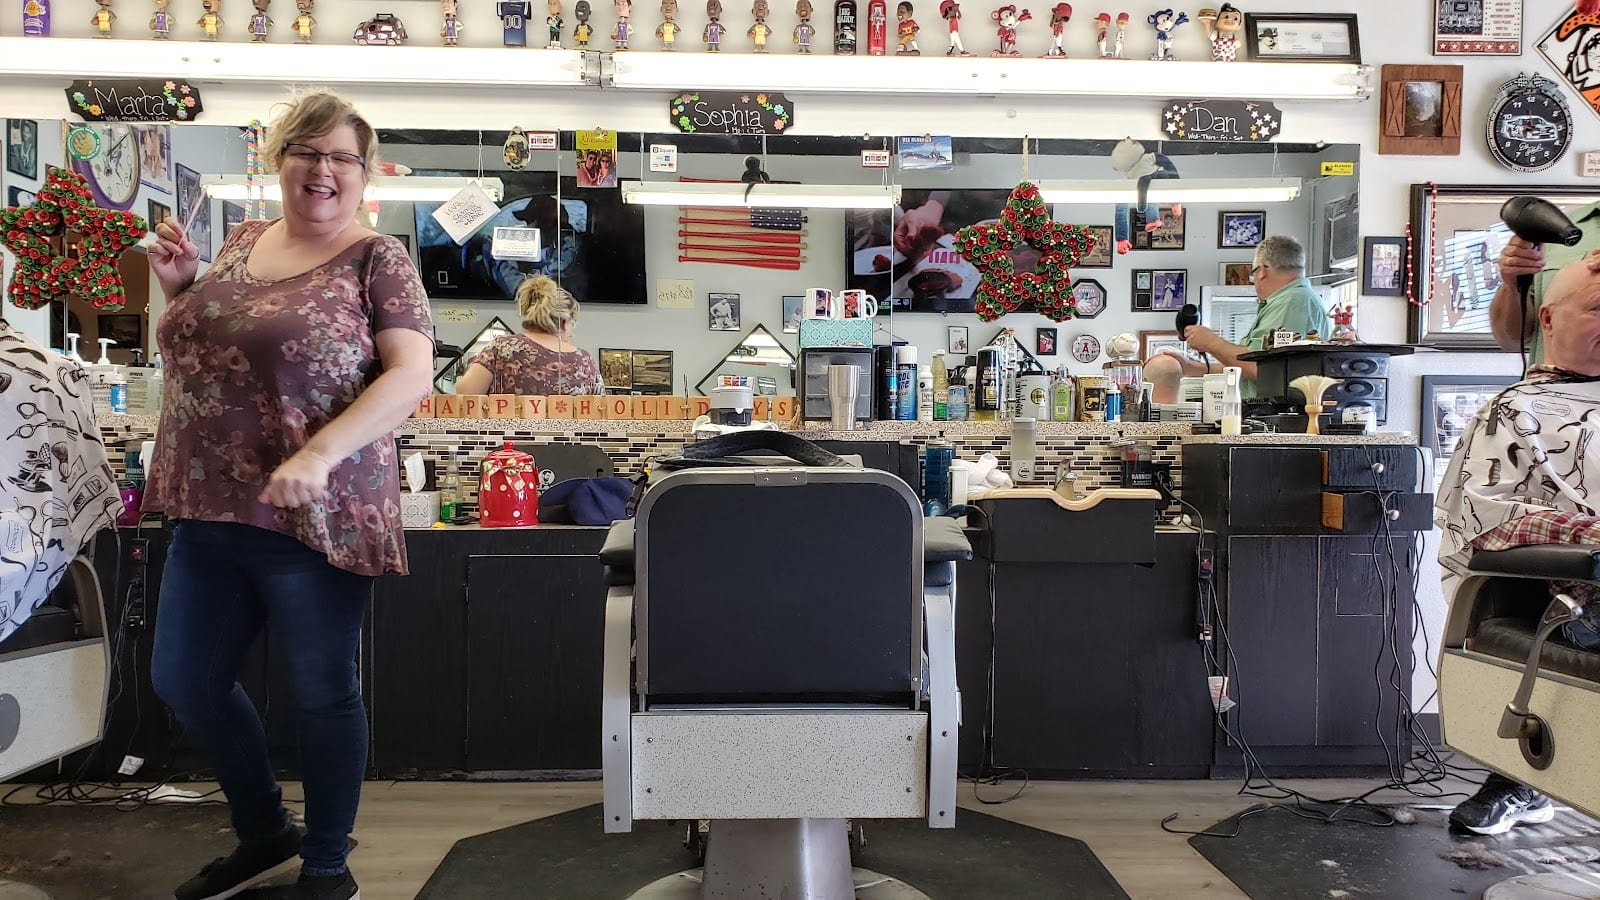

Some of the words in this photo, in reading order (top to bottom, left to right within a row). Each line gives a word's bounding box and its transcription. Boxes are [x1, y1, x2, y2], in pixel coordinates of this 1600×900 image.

[94, 86, 168, 115] Marta
[694, 102, 763, 132] Sophia
[1189, 107, 1238, 134] Dan
[419, 400, 542, 415] HAPPY
[580, 400, 787, 416] HOLIDYS
